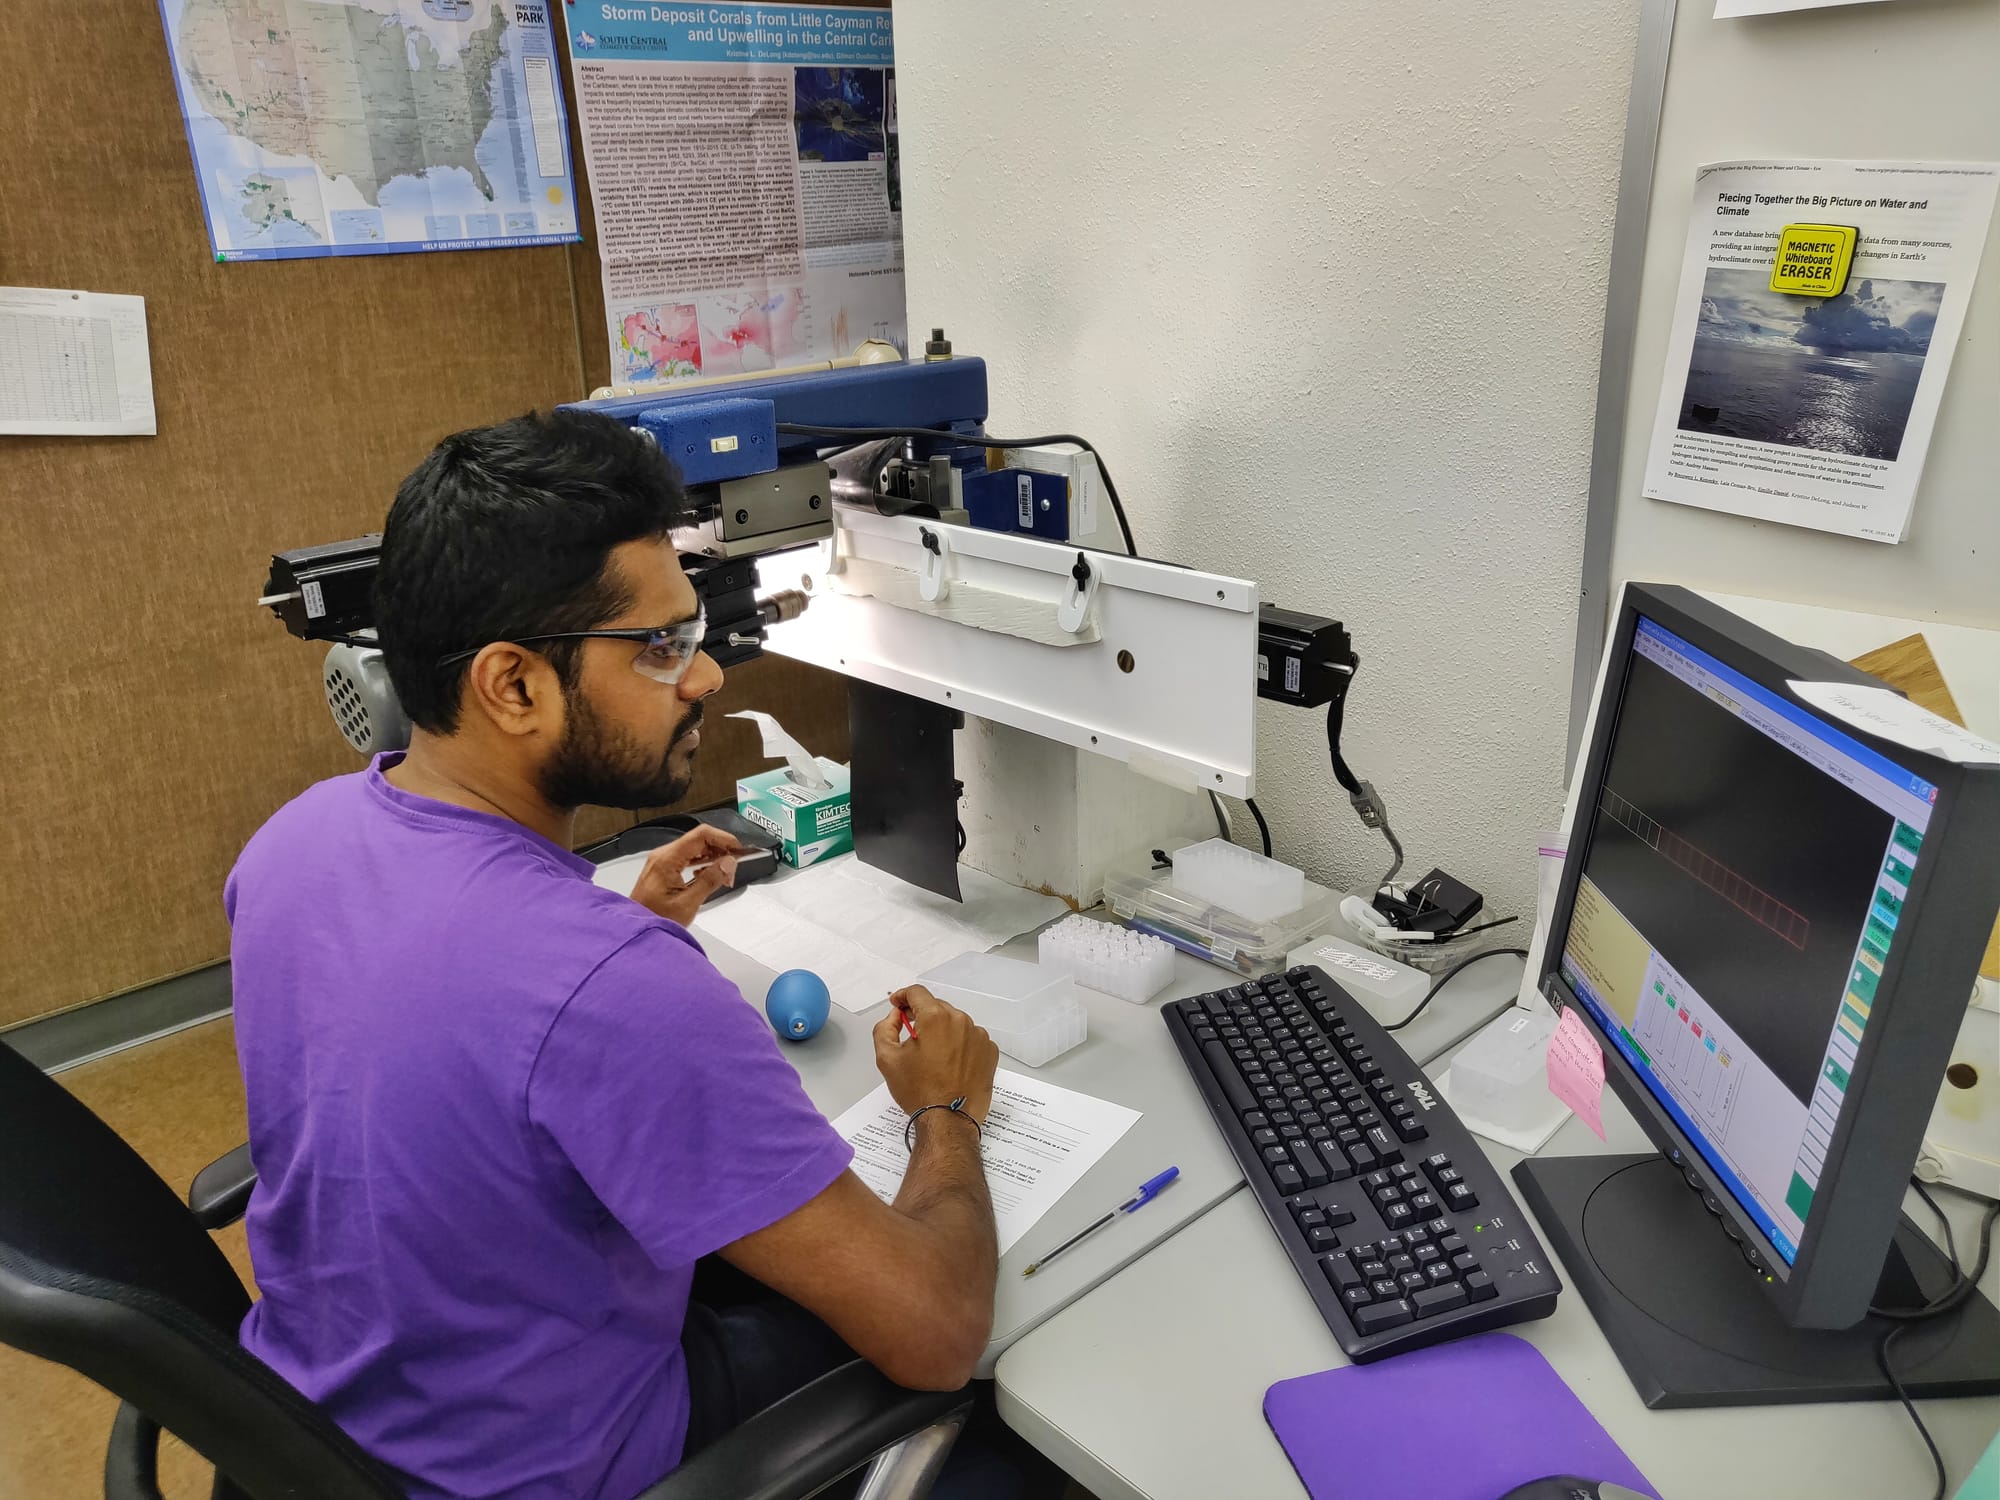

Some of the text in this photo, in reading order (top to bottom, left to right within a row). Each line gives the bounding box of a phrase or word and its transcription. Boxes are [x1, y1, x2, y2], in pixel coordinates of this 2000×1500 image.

[517, 12, 544, 23] PARK
[602, 6, 646, 22] Storm
[651, 8, 705, 25] Deposit
[710, 9, 752, 25] Corals
[757, 11, 786, 25] from
[791, 12, 822, 28] Little
[825, 14, 872, 32] Cayman
[599, 35, 666, 46] SOUTH CENTRAL
[689, 28, 713, 41] and
[718, 28, 783, 47] Upwelling
[787, 30, 798, 44] in
[802, 30, 821, 45] the
[824, 31, 866, 46] Central
[1718, 193, 1752, 204] Piecing
[1754, 194, 1794, 205] Together
[1795, 195, 1809, 205] the
[1812, 196, 1827, 207] Big
[1829, 196, 1862, 207] Picture
[1880, 198, 1907, 209] Water
[1909, 200, 1928, 209] and
[1717, 206, 1750, 216] Climate
[1734, 230, 1765, 238] database
[448, 241, 475, 249] PROTECT
[476, 240, 489, 248] AND
[490, 238, 518, 247] PRESERVE
[532, 236, 560, 245] NATIONAL
[1710, 242, 1742, 251] providing
[1788, 241, 1836, 253] MAGNETIC
[1900, 240, 1921, 248] many
[1708, 254, 1750, 264] hydroclimate
[1785, 253, 1832, 265] Whiteboard
[1861, 250, 1889, 259] changes
[1900, 252, 1926, 260] Earth's
[1780, 264, 1832, 280] ERASER
[1680, 434, 1710, 443] thunderstorm
[1797, 453, 1827, 462] investigating
[1828, 456, 1860, 467] hydroclimate
[1861, 463, 1878, 471] during
[1672, 451, 1692, 459] hydrogen
[1744, 463, 1773, 472] precipitation
[816, 802, 851, 821] KIMTEC
[747, 810, 783, 836] KIMTECH
[1407, 1081, 1437, 1111] DELL
